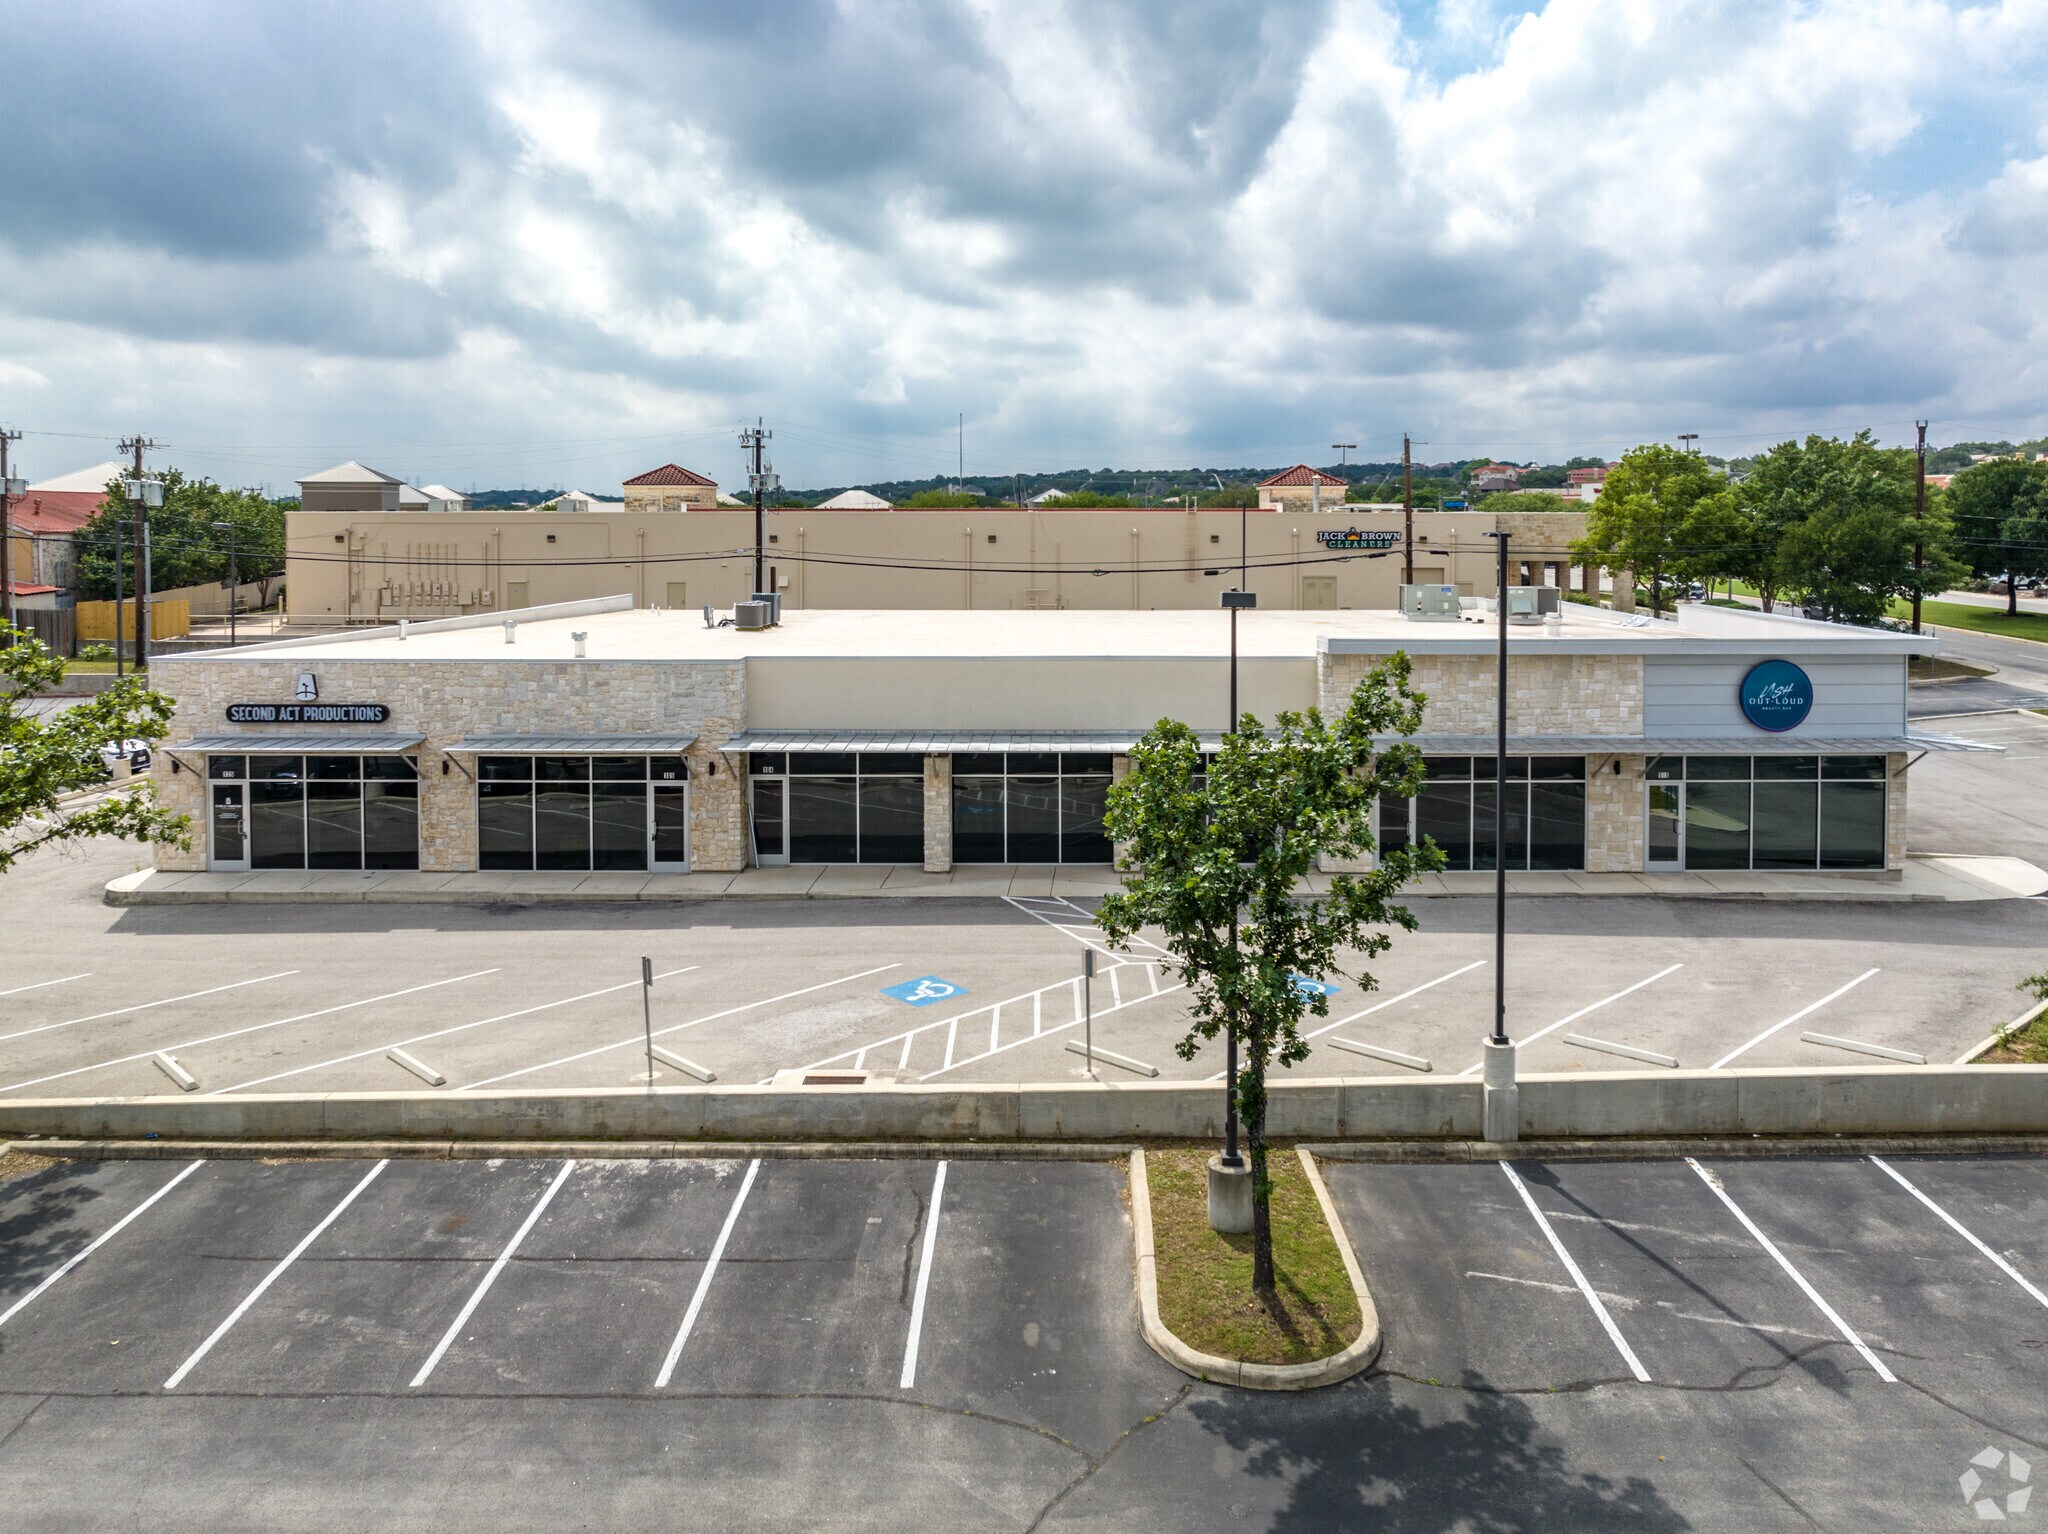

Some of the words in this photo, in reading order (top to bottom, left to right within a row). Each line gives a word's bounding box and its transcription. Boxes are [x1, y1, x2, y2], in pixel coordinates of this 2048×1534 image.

[1318, 532, 1346, 541] JACK
[1361, 532, 1401, 540] BROWN
[1328, 540, 1391, 548] CLEANERS
[1748, 697, 1804, 705] OUT-LOUD
[231, 706, 276, 721] SECOND
[278, 706, 300, 721] ACT
[303, 706, 383, 721] PRODUCTIONS
